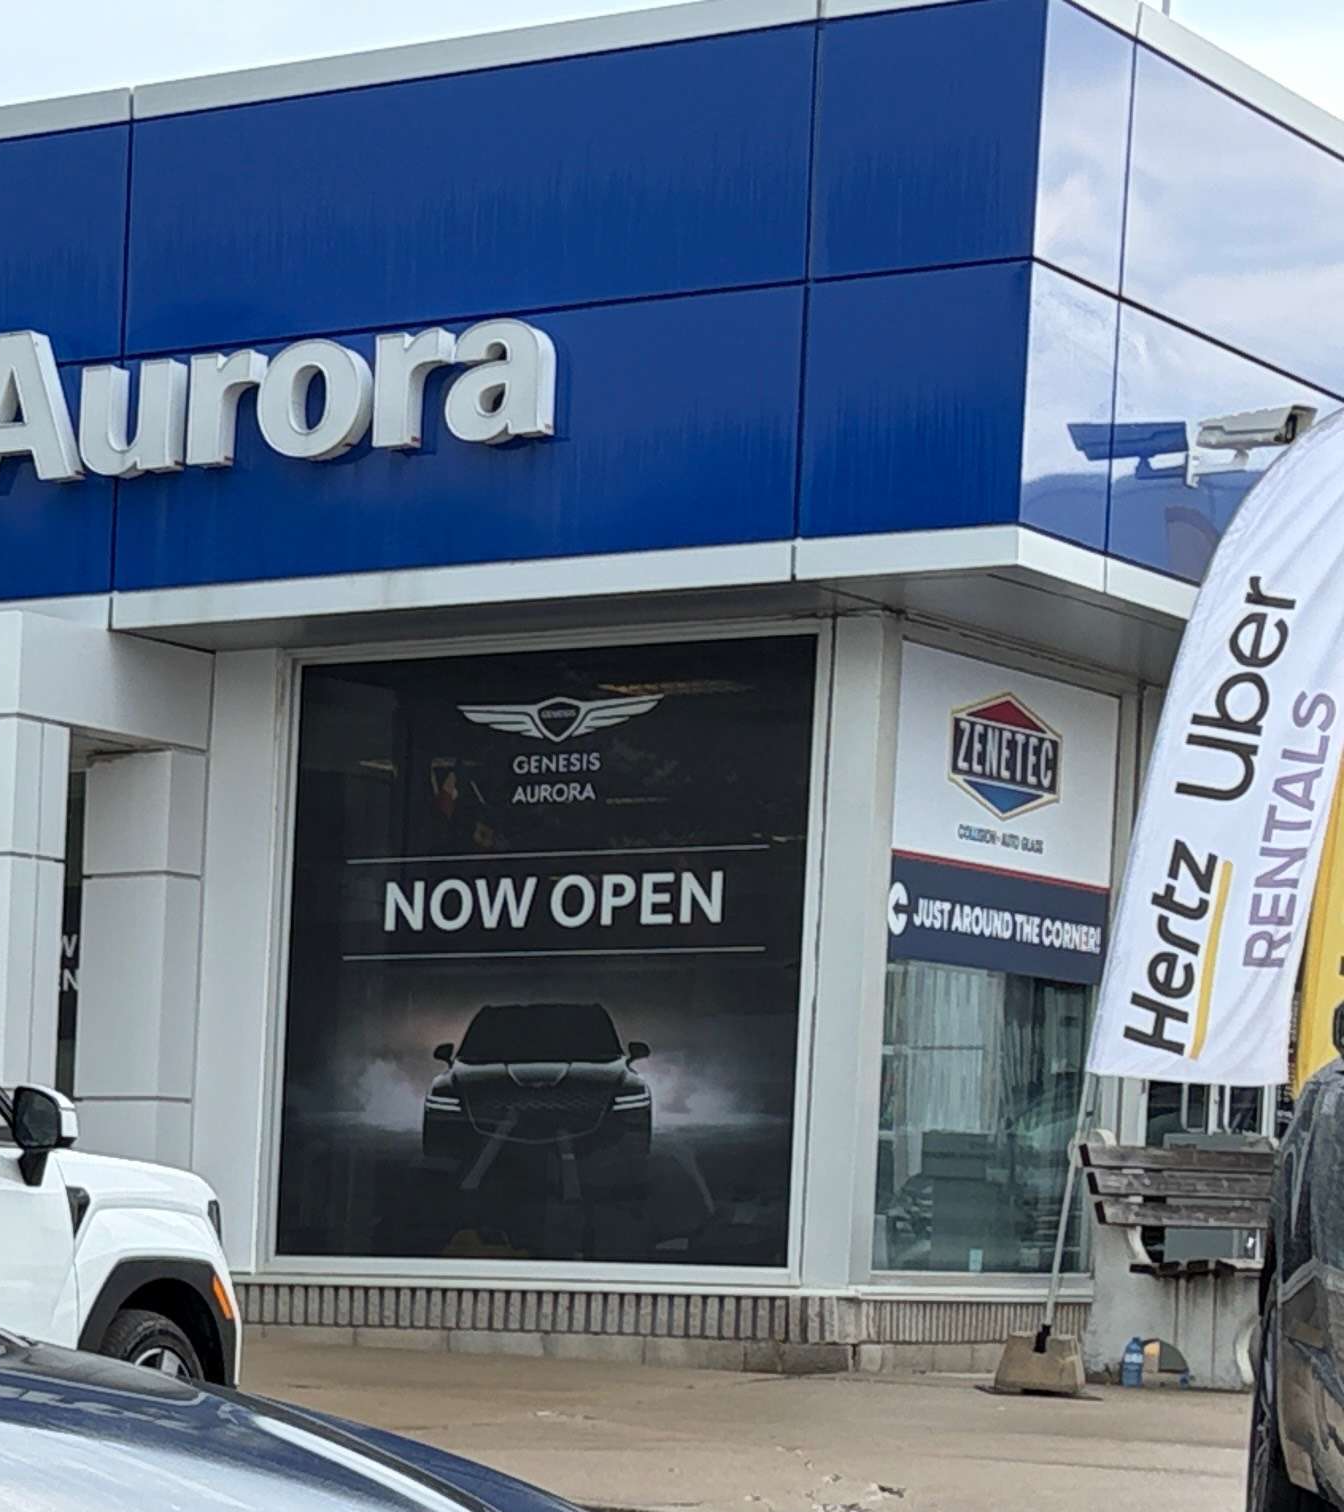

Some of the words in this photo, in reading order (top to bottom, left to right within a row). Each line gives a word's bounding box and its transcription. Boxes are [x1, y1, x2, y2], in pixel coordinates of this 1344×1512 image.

[513, 752, 601, 774] GENESIS
[957, 720, 1054, 789] ZENETEC
[512, 783, 596, 804] AURORA
[1123, 839, 1218, 1056] Hertz
[1175, 576, 1296, 803] Uber
[1242, 690, 1337, 970] RENTALS
[384, 876, 538, 931] NOW
[550, 870, 724, 928] OPEN
[913, 898, 952, 931] JUST
[951, 903, 1012, 940] AROUND
[1014, 913, 1041, 944] THE
[1042, 918, 1102, 954] CORNER!
